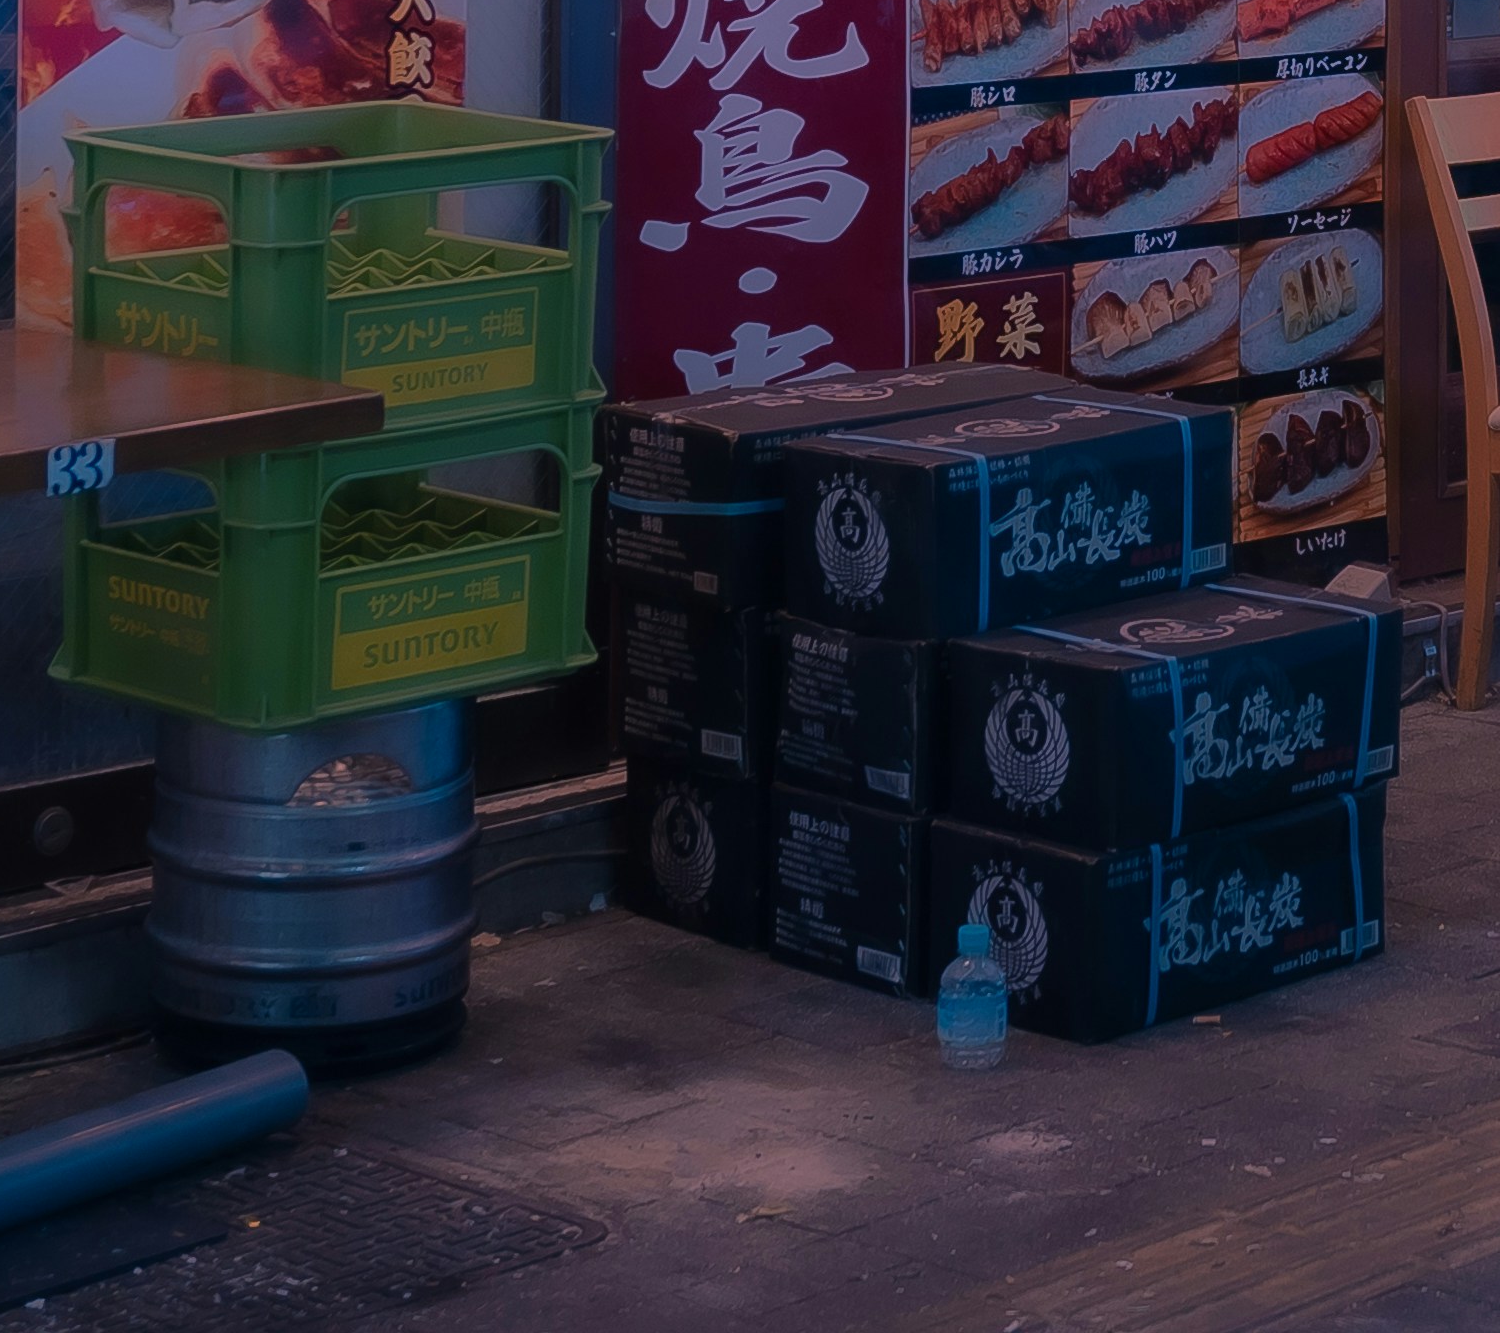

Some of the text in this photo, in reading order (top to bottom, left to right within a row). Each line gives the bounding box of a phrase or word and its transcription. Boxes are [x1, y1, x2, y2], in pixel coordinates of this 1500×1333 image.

[1276, 54, 1368, 79] 厚切りベーコン
[1133, 70, 1177, 92] 豚タン
[970, 85, 1016, 108] 豚シロ
[1286, 209, 1353, 232] ソーセージ
[1133, 230, 1178, 254] 豚ハツ
[962, 248, 1024, 276] 豚カシラ
[116, 299, 218, 357] サントリー
[354, 315, 469, 358] サントリー
[934, 291, 1045, 364] 野菜
[391, 362, 489, 393] SUNTORY
[1297, 368, 1329, 390] 長ネギ
[52, 443, 103, 497] 33
[1295, 529, 1347, 555] しいたけ
[368, 585, 455, 619] サントリー
[362, 621, 500, 669] SUNTORY
